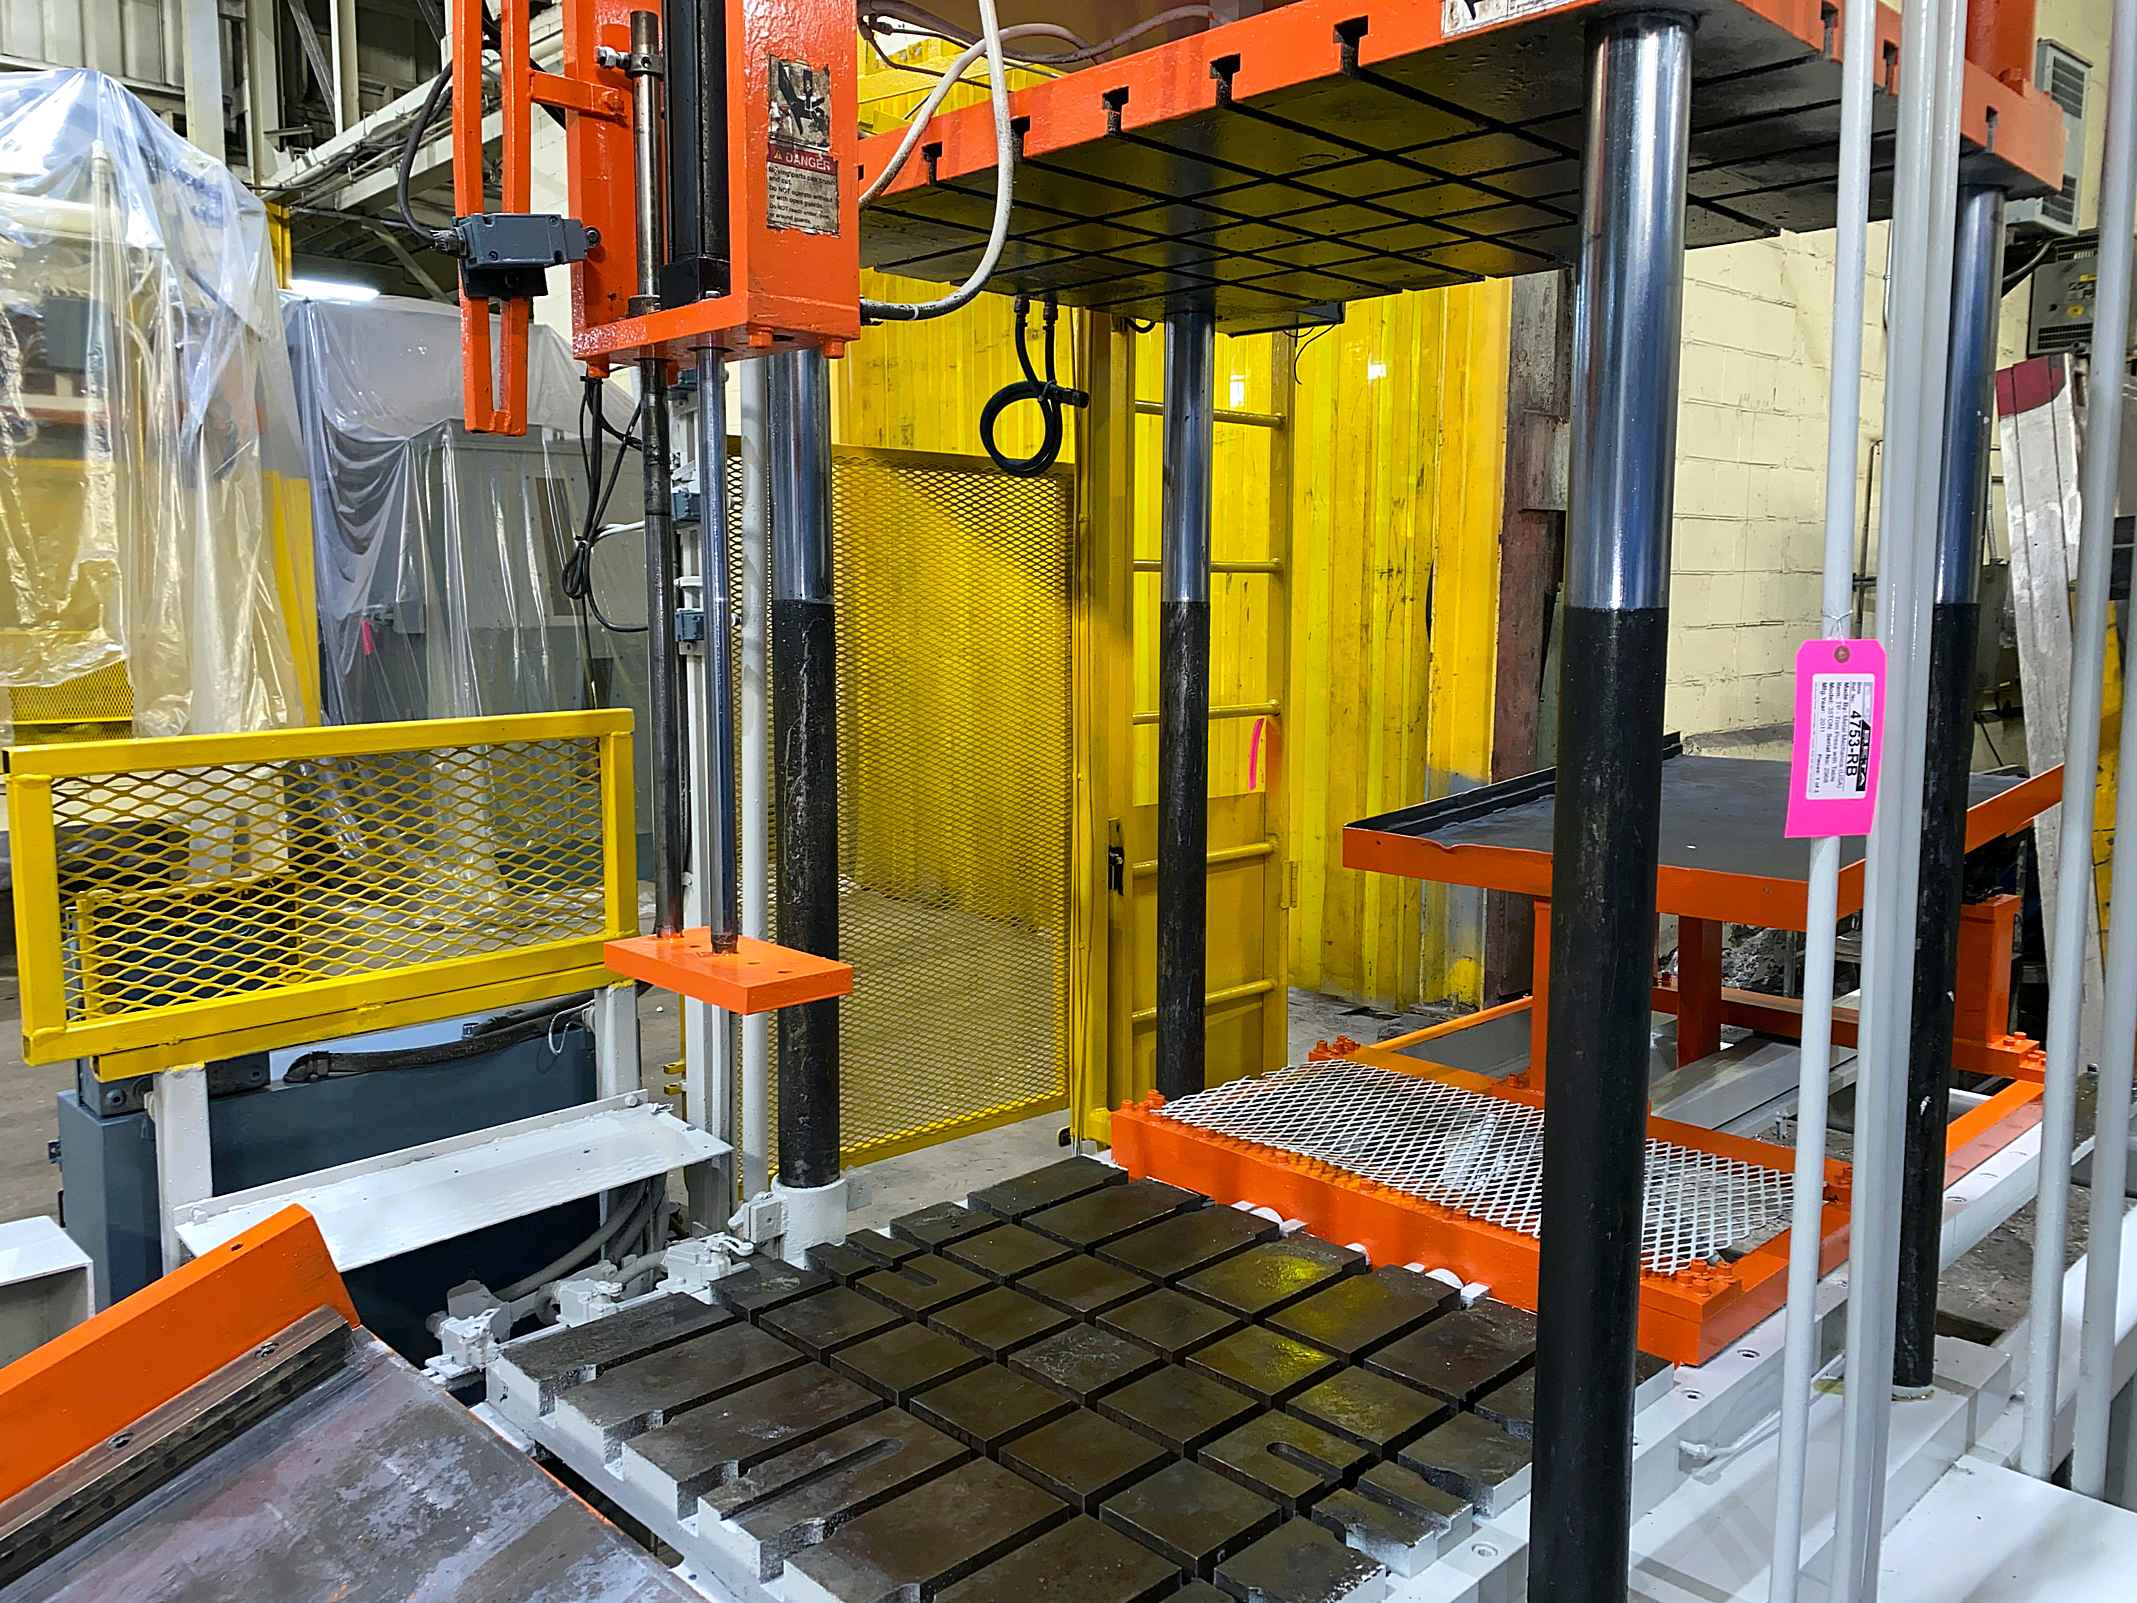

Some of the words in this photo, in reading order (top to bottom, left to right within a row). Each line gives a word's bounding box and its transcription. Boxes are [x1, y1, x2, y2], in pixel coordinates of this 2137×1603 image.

[785, 152, 831, 171] DANGER
[778, 186, 790, 194] NOT
[1846, 710, 1862, 776] 4753-RB
